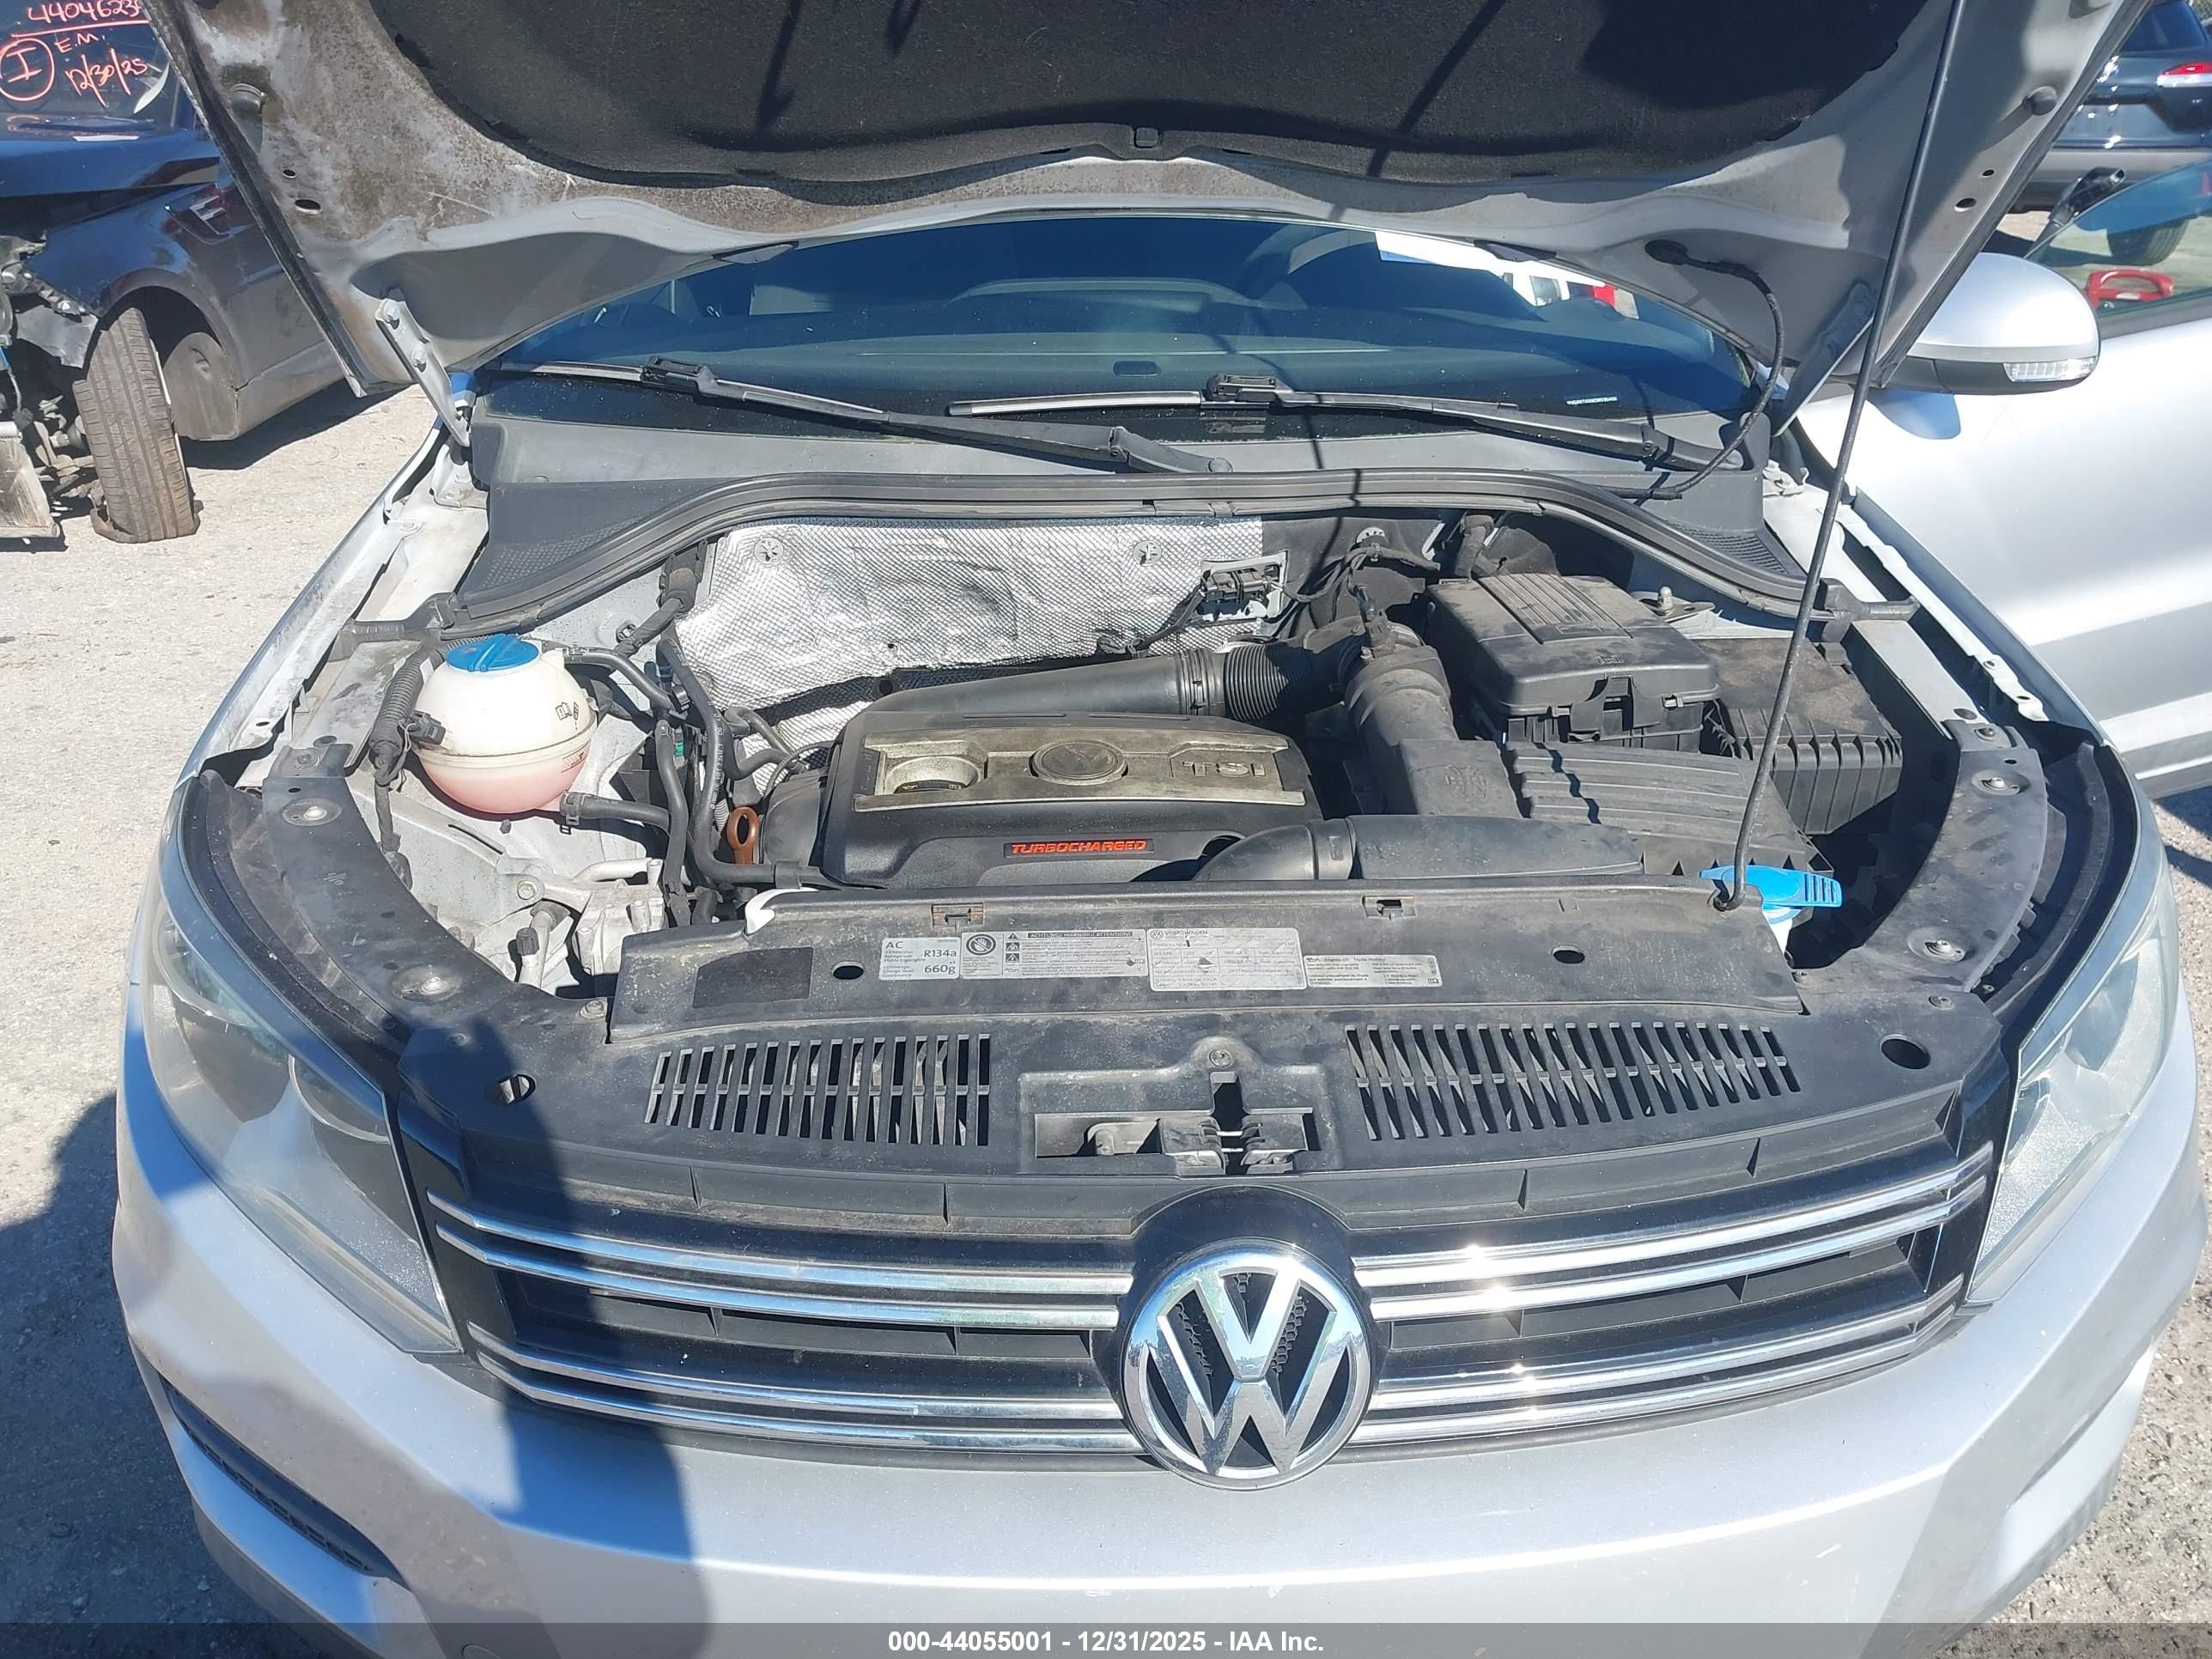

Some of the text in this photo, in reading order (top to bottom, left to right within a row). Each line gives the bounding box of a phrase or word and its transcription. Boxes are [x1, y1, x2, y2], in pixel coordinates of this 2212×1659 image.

[1182, 761, 1266, 777] TSI
[1011, 841, 1147, 854] TURBOCHARGED
[924, 949, 957, 957] R134a
[924, 964, 956, 975] 660g
